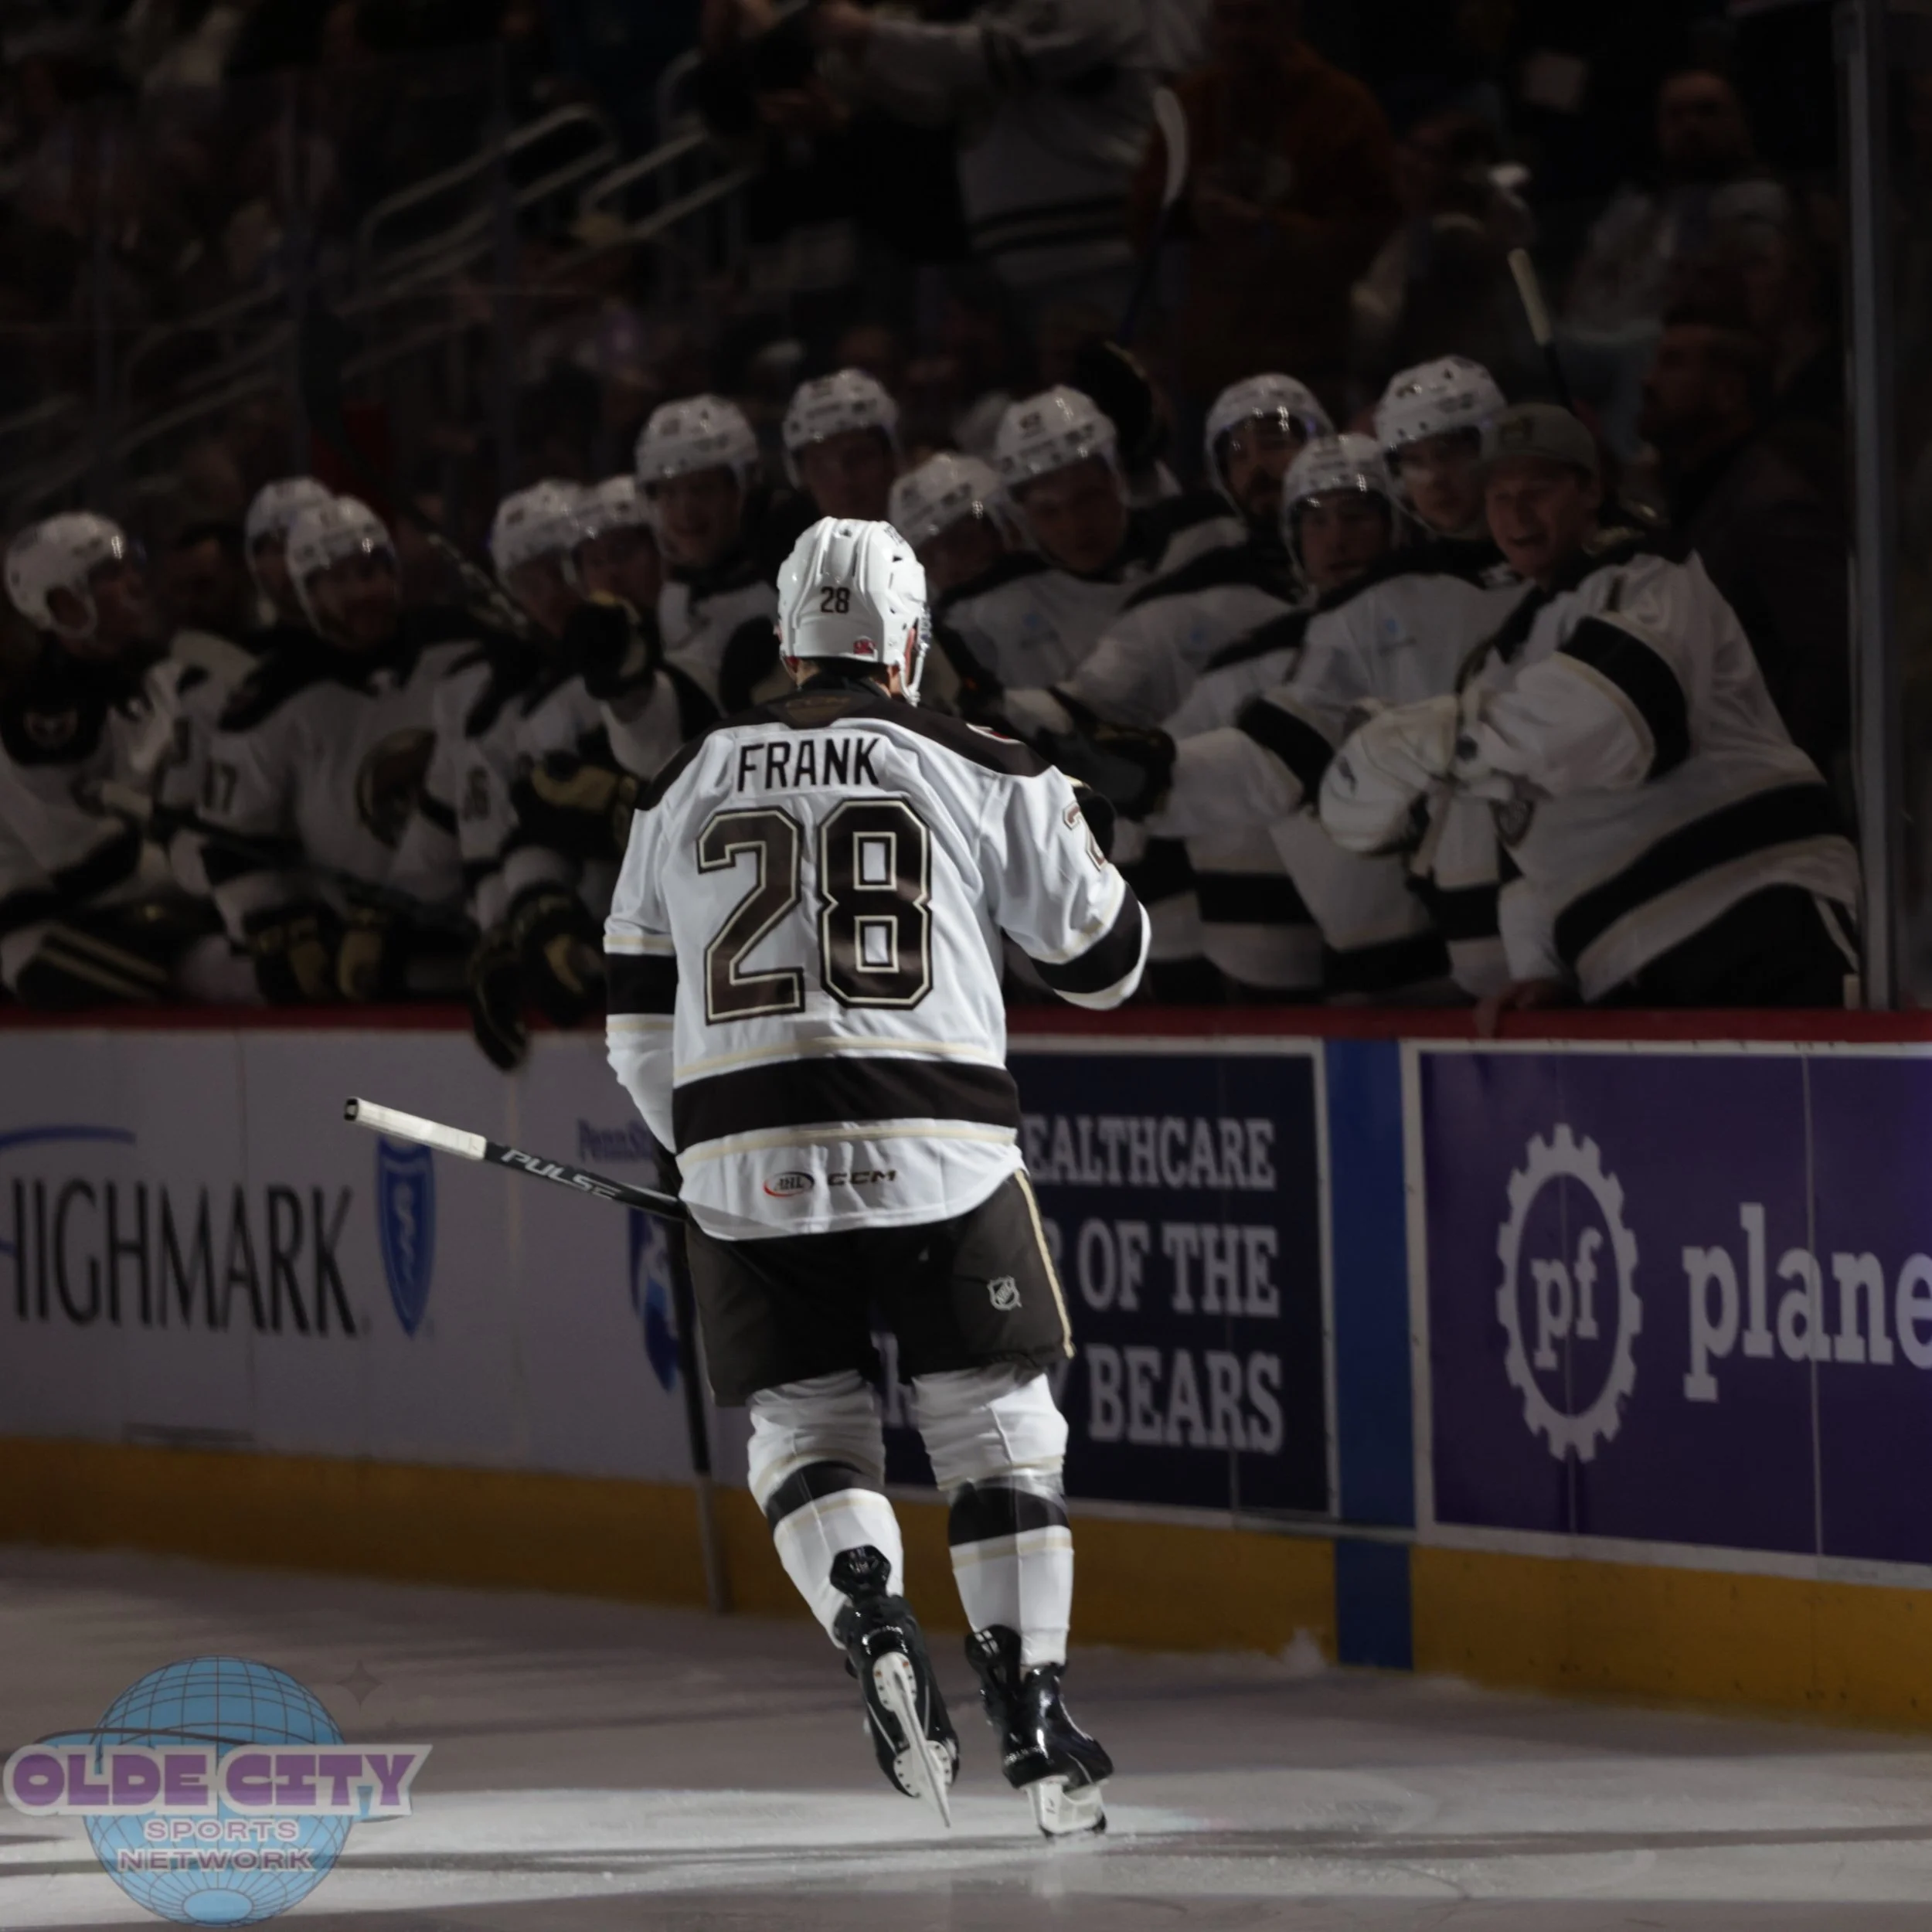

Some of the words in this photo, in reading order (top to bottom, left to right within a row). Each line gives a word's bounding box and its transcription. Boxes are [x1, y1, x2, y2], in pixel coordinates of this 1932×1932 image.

[821, 586, 850, 614] 28
[737, 737, 879, 793] FRANK
[698, 798, 934, 1026] 28
[501, 1148, 623, 1200] PULSE
[828, 1169, 896, 1185] CCM
[1077, 1216, 1151, 1314] OF
[1160, 1220, 1282, 1320] THE
[1530, 1226, 1604, 1372] pf
[1682, 1201, 1932, 1404] plane
[1083, 1342, 1286, 1457] BEARS
